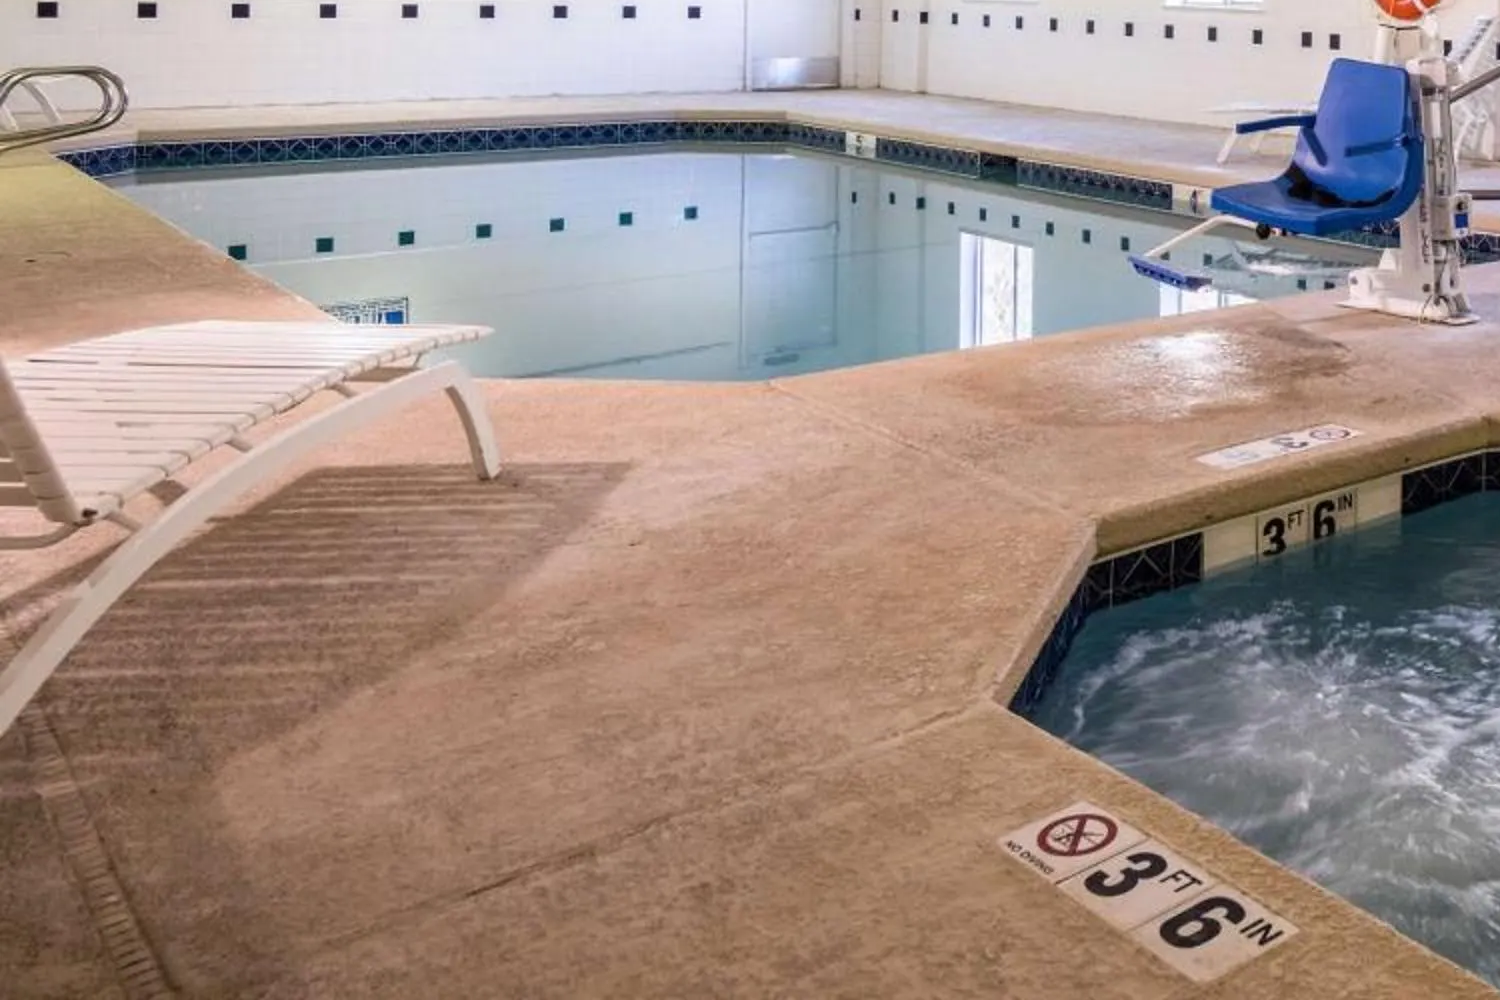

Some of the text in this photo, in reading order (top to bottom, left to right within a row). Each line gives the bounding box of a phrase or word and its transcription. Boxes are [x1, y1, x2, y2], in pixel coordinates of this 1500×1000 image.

[1263, 491, 1352, 556] 3 FT 6 IN
[1084, 852, 1284, 948] 3 FT 6 IN
